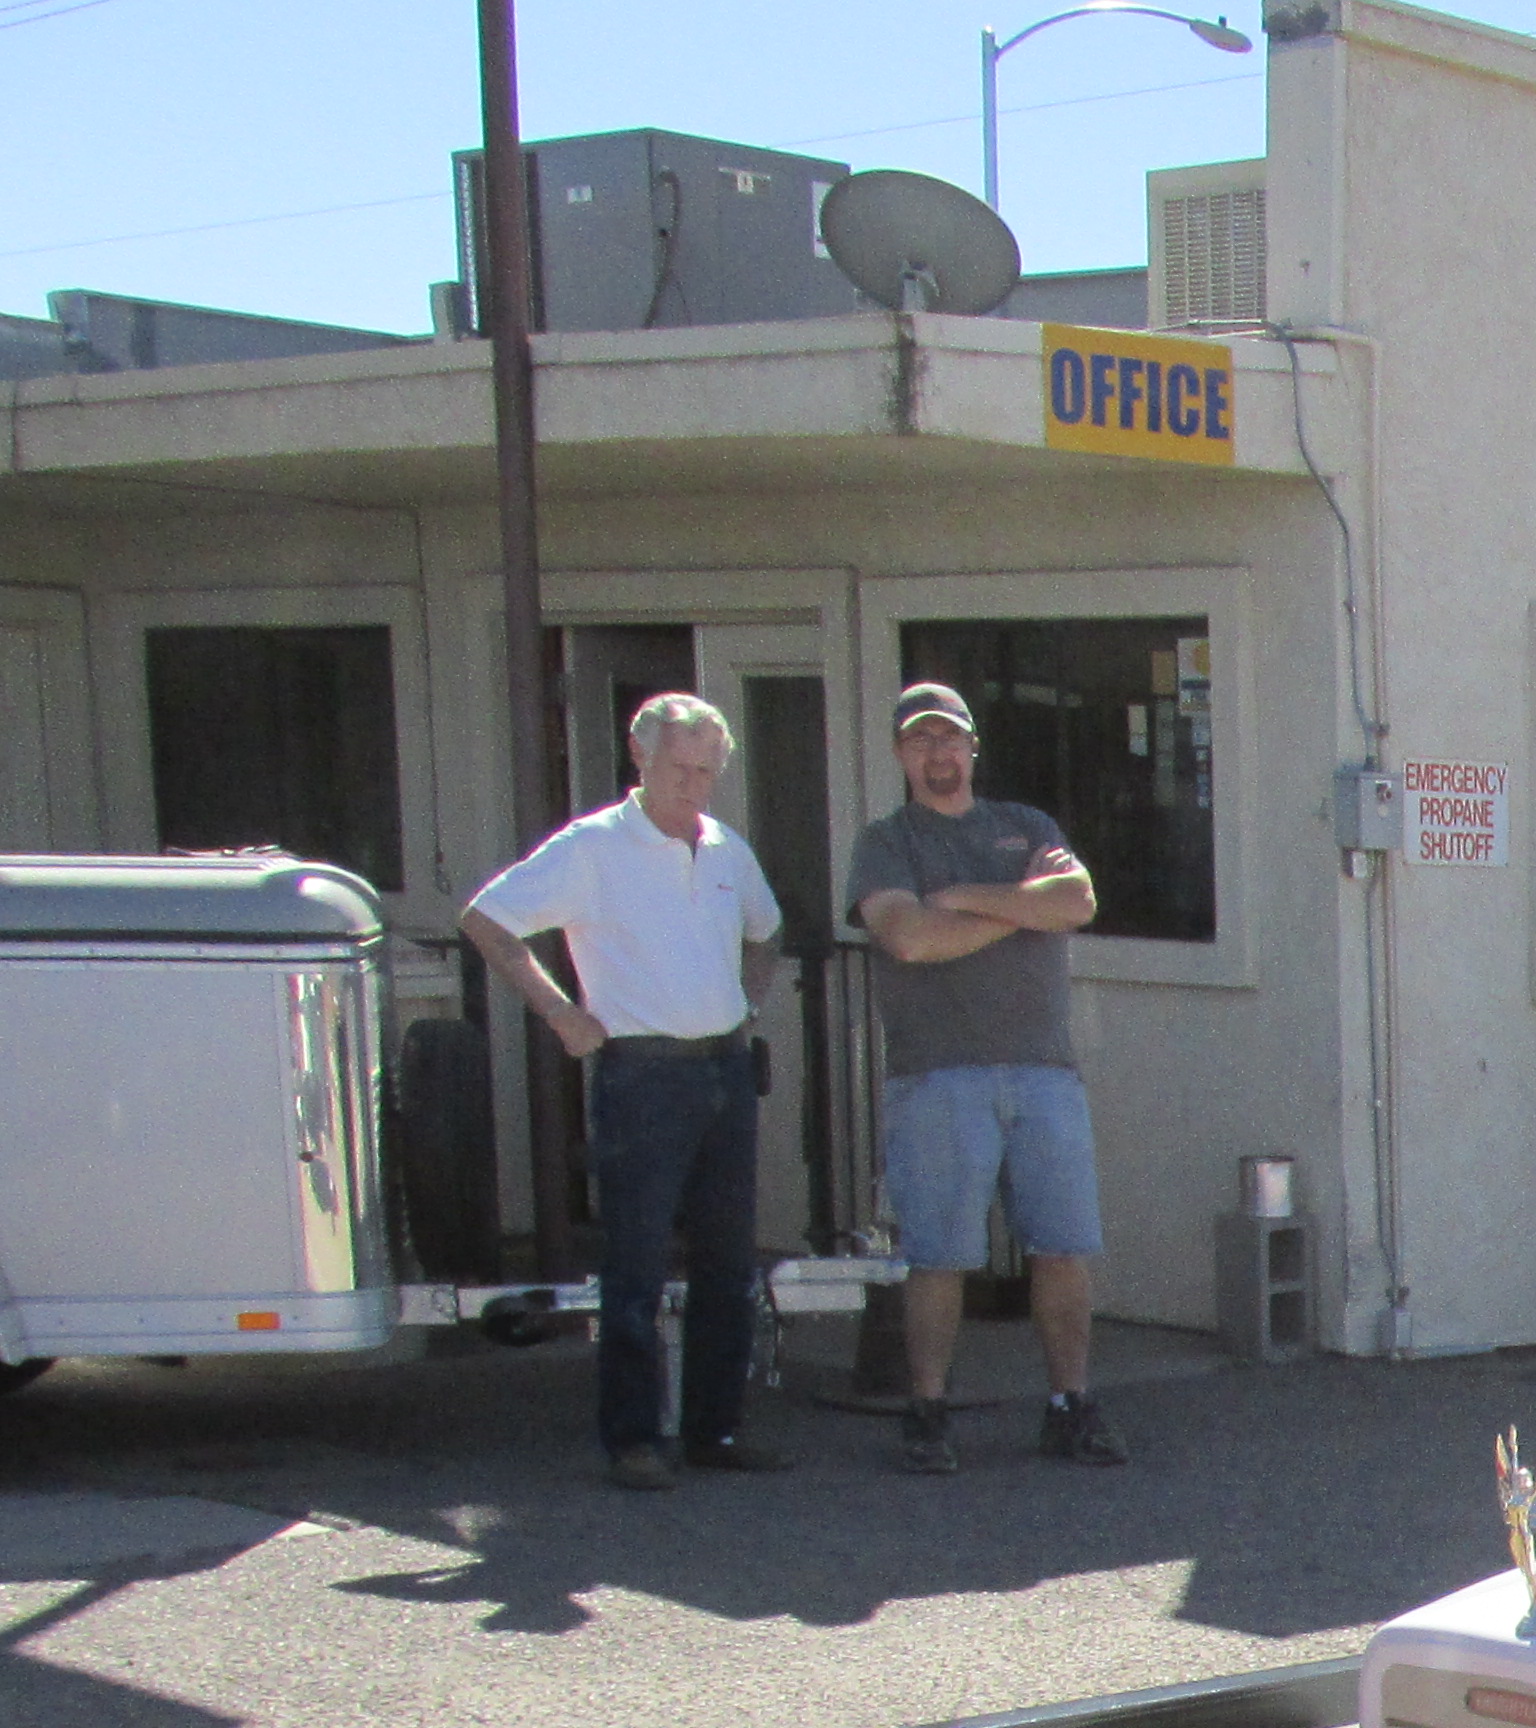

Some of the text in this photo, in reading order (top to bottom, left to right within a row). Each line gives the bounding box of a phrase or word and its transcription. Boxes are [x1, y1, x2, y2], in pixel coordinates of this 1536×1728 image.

[1051, 347, 1231, 439] OFFICE
[1405, 762, 1507, 795] EMERGENCY
[1420, 797, 1494, 828] PROPANE
[1420, 831, 1495, 861] SHUTOFF
